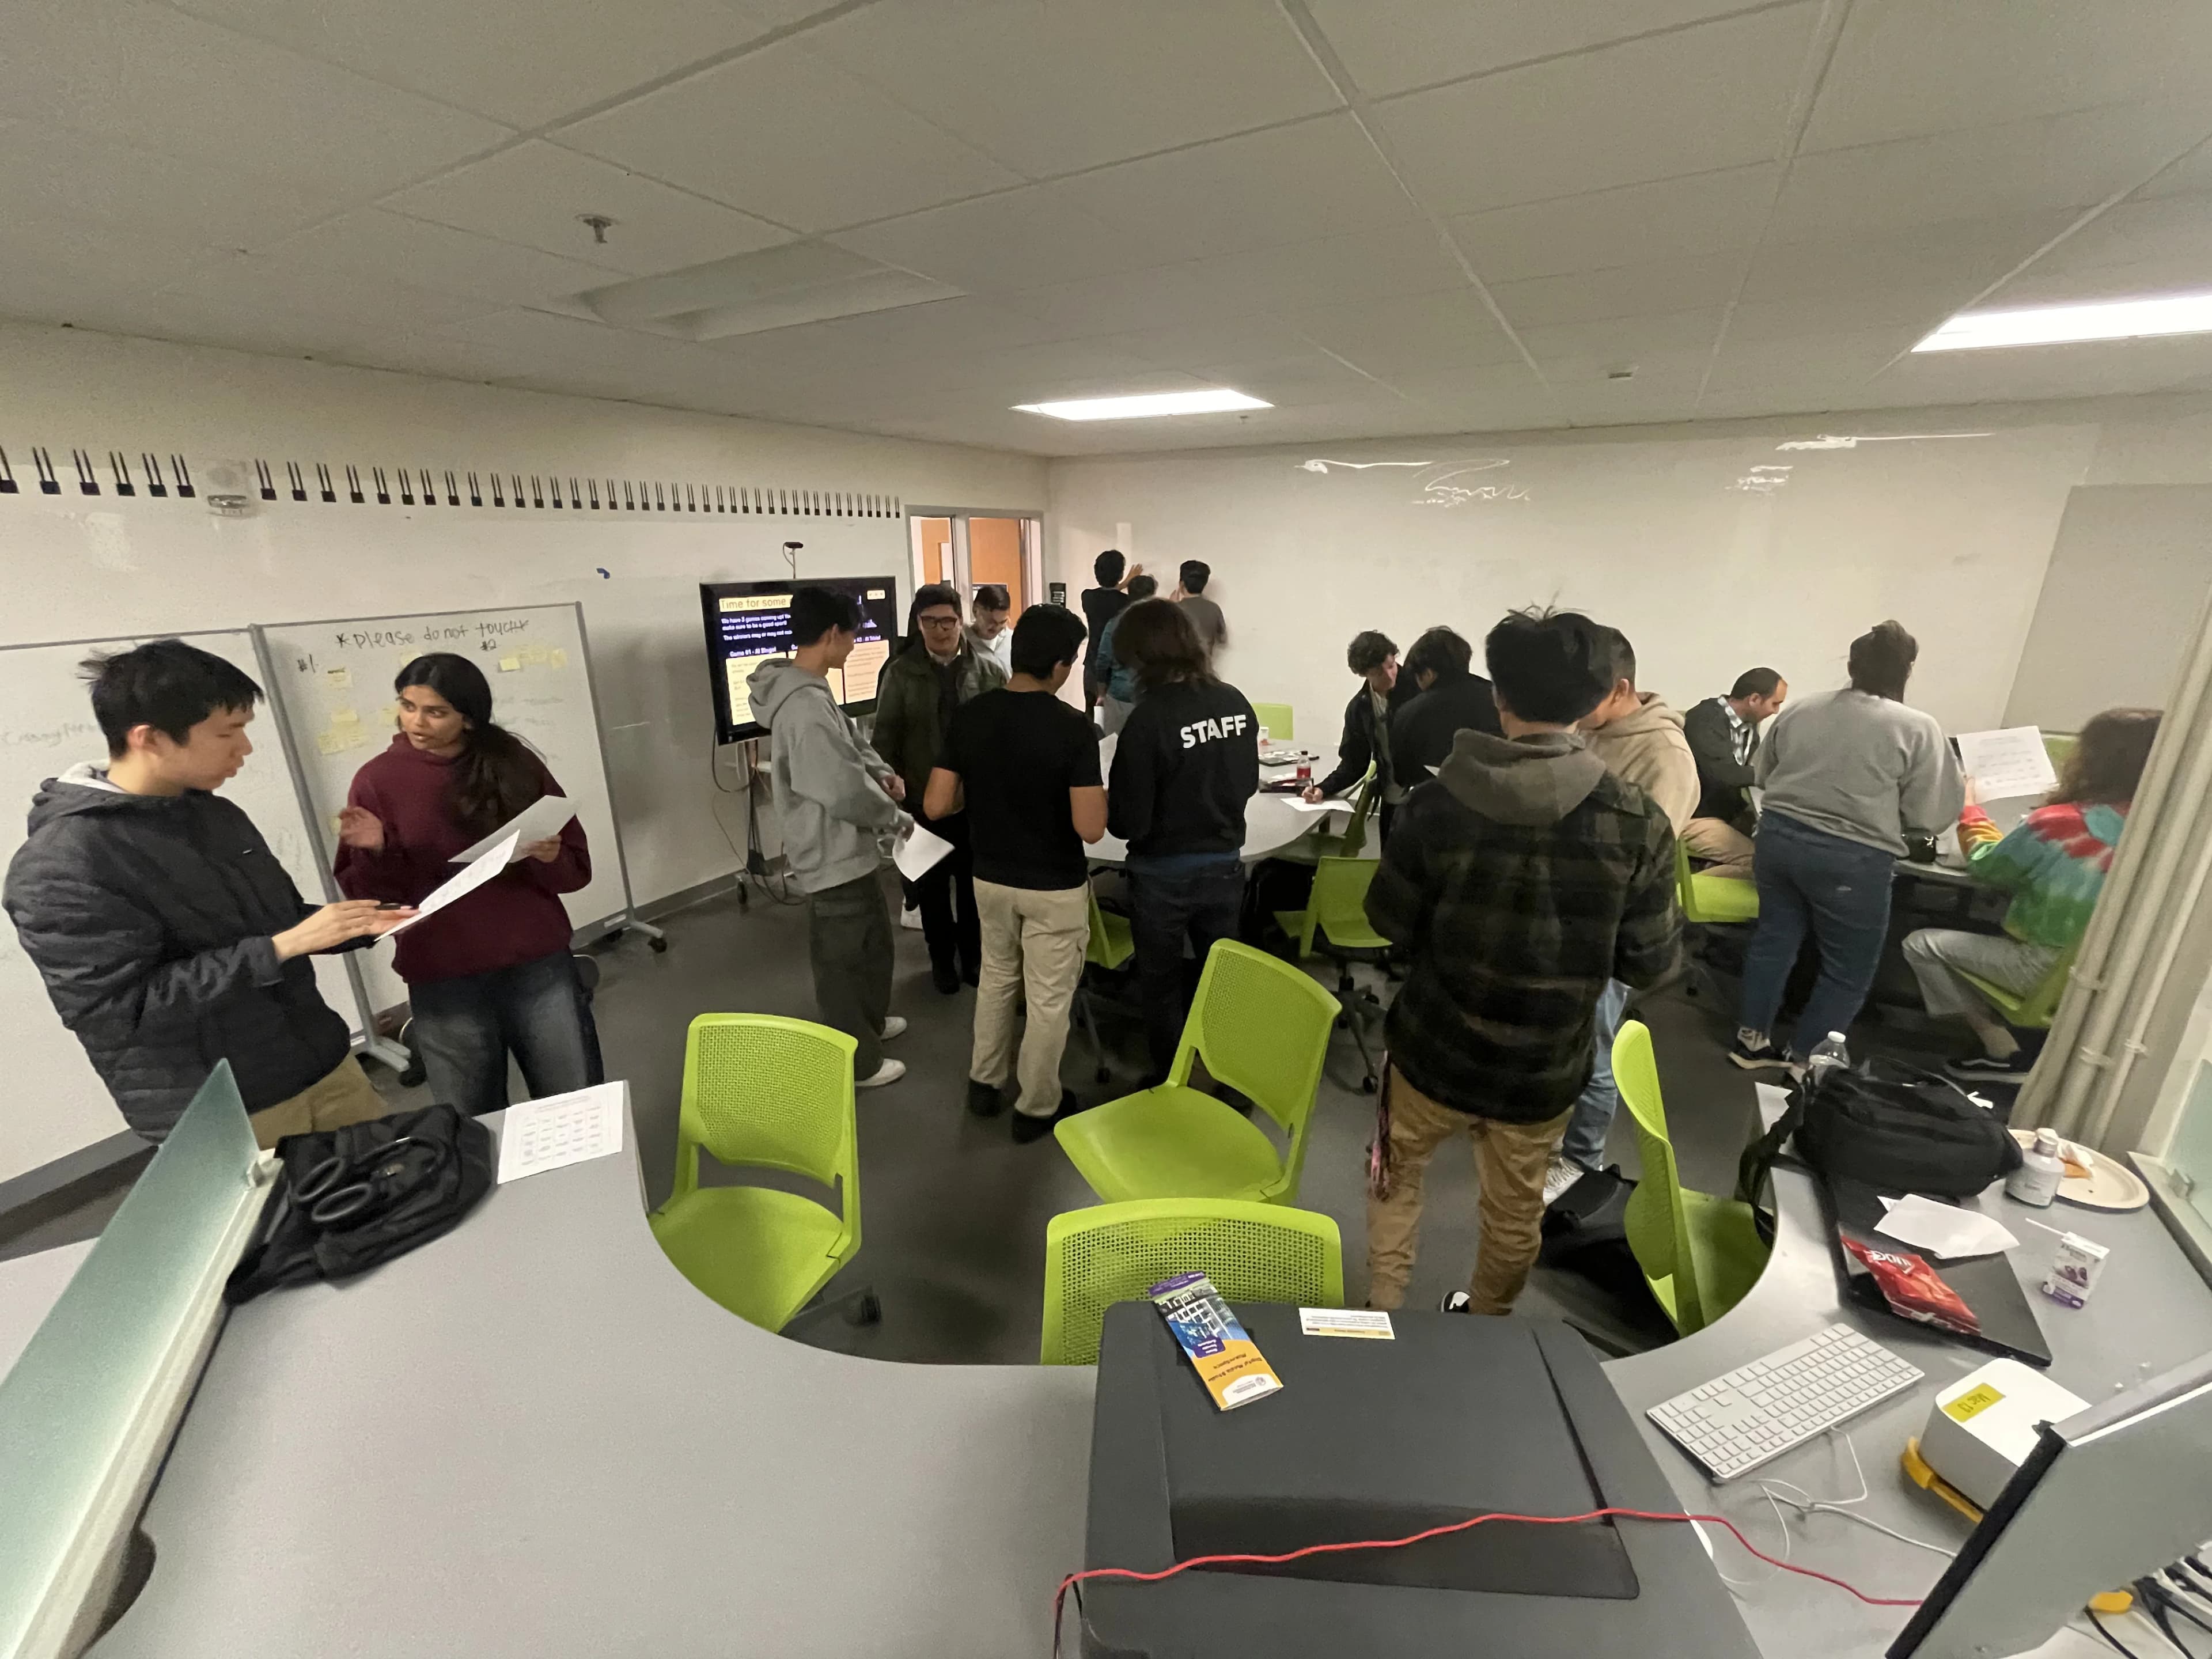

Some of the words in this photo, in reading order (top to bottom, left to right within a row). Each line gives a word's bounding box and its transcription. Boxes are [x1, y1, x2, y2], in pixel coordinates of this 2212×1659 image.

[721, 600, 743, 609] Time
[747, 599, 759, 608] for
[762, 598, 786, 607] some
[424, 626, 440, 641] do
[444, 625, 469, 639] not
[1180, 714, 1247, 748] STAFF
